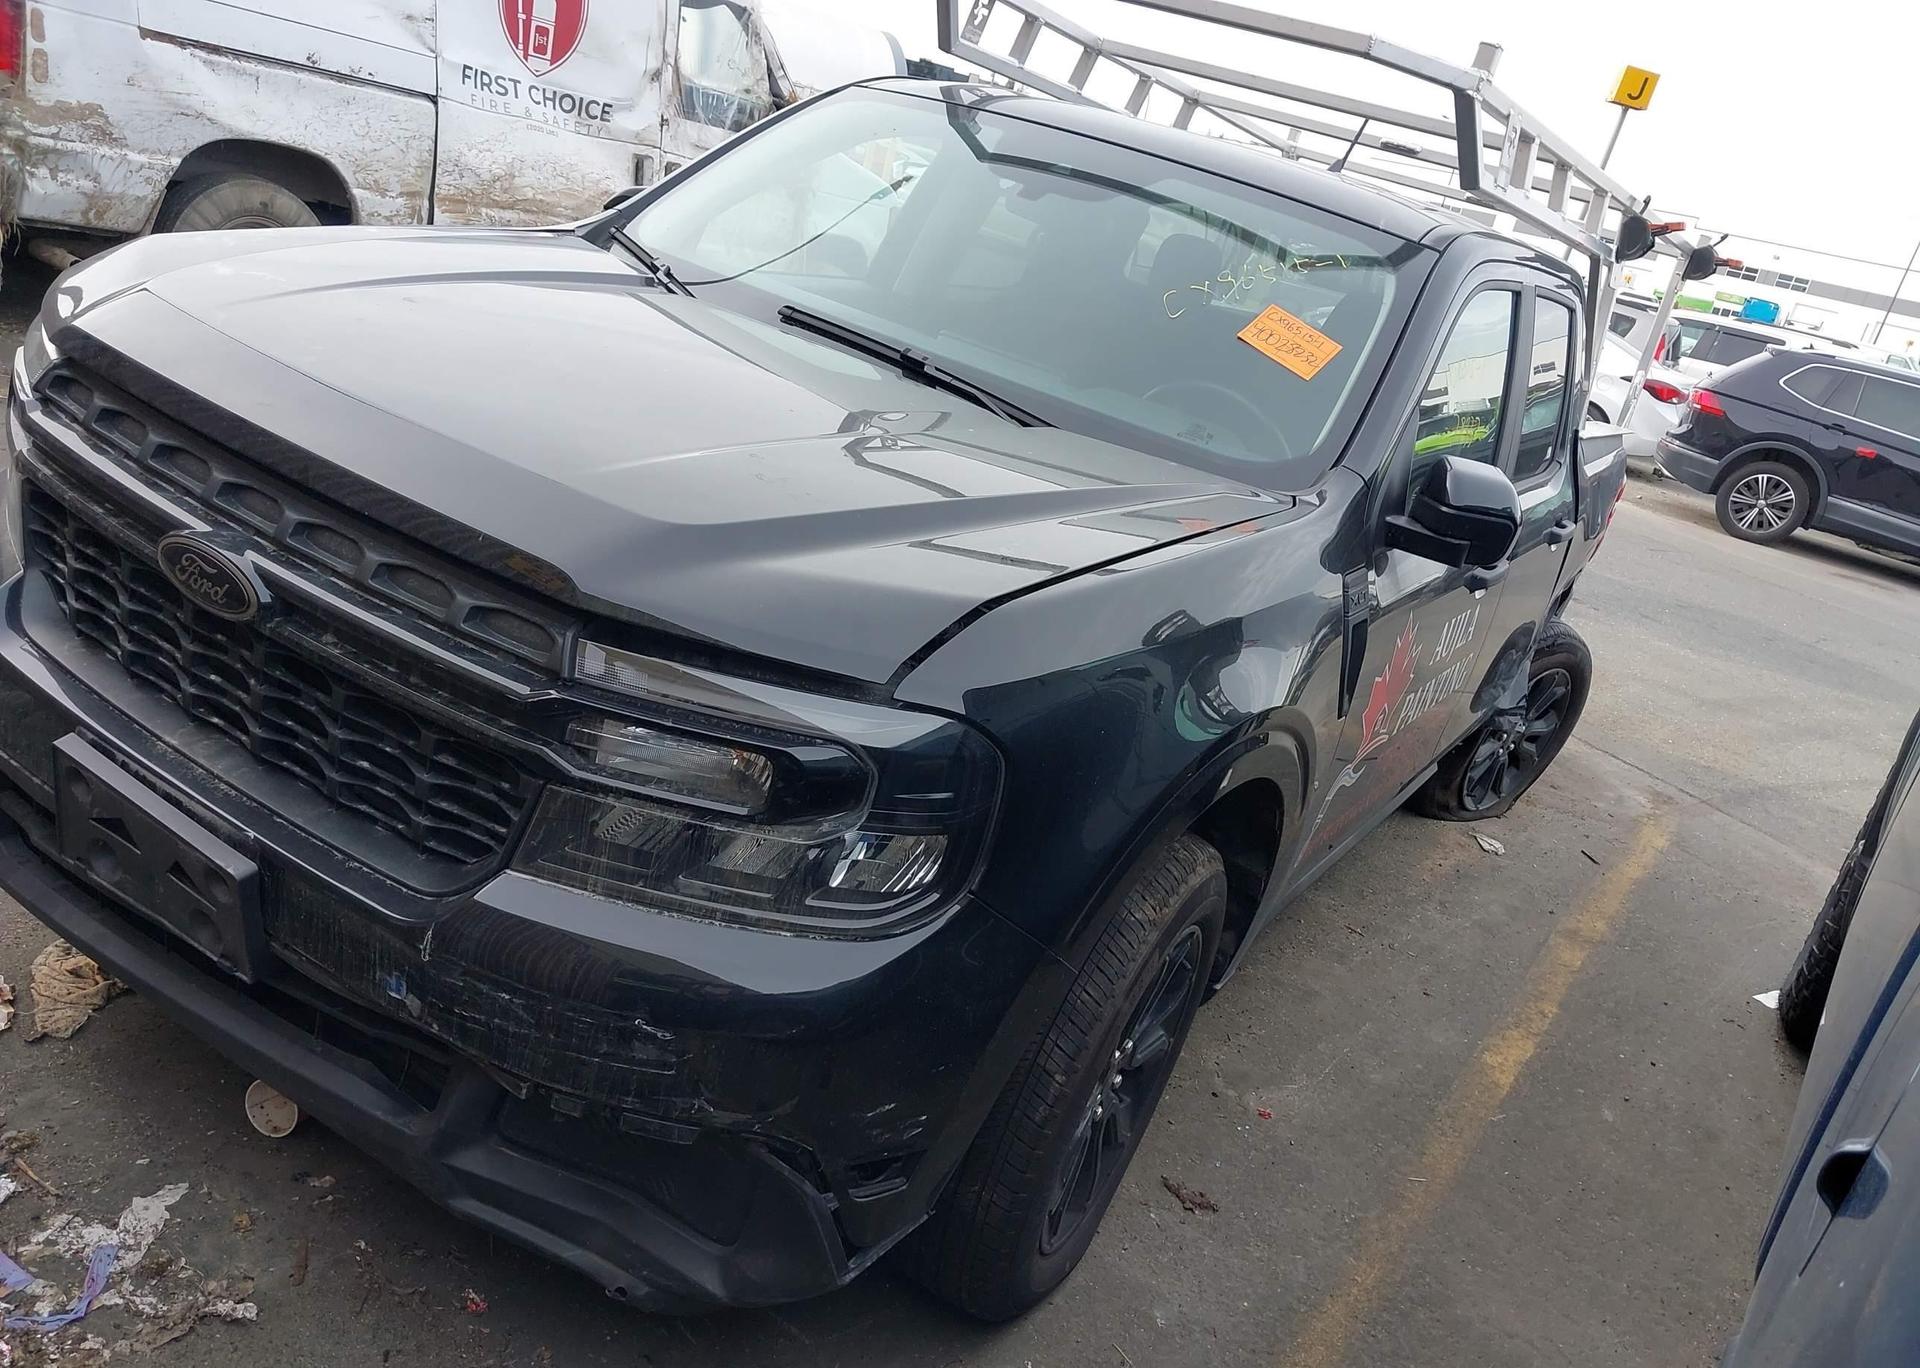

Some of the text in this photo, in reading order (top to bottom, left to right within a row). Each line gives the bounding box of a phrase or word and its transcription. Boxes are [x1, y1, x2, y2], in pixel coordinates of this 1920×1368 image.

[535, 33, 548, 47] 1st
[462, 64, 613, 123] FIRST CHOICE
[1627, 77, 1649, 100] J
[471, 94, 603, 137] FIRE & SAFETY
[175, 553, 231, 604] Ford
[1391, 653, 1474, 737] PAINTING
